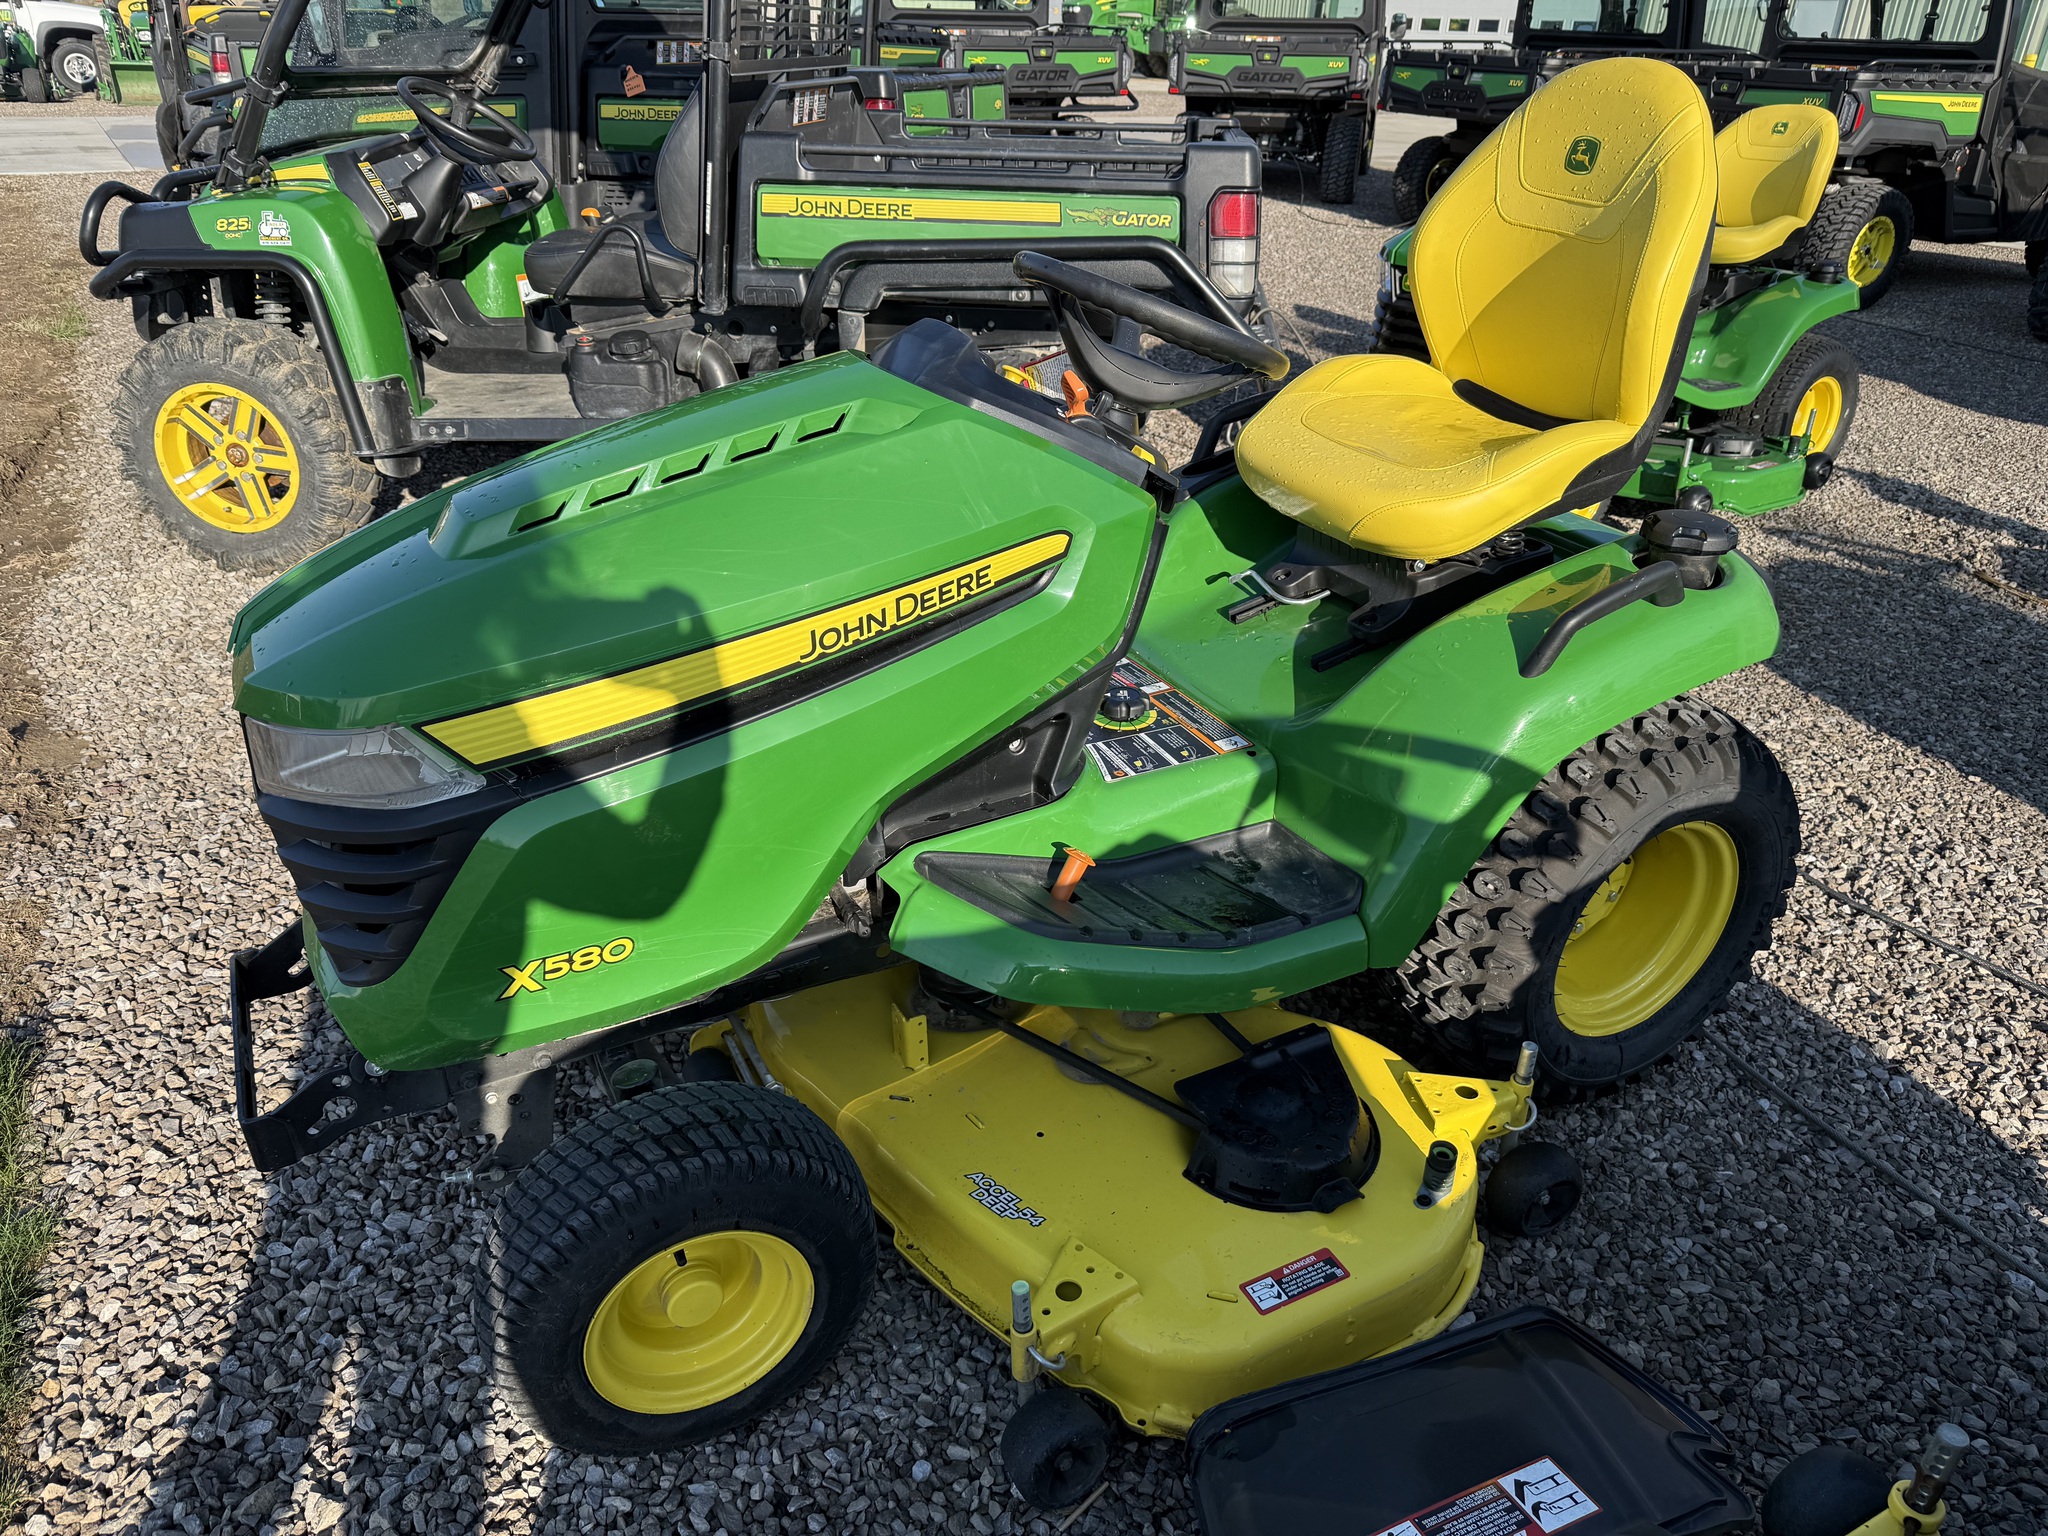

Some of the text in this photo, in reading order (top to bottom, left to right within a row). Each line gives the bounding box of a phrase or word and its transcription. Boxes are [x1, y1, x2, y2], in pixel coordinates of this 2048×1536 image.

[1097, 56, 1112, 64] XUV
[1328, 61, 1344, 69] XUV
[1015, 69, 1069, 82] GATOR
[1237, 71, 1295, 84] GATOR
[1508, 79, 1523, 87] XUV
[1802, 97, 1824, 106] XUV
[1948, 100, 1978, 108] JOHN DEERE
[614, 106, 680, 119] JOHN DEER
[789, 197, 912, 218] JOHN DEERE
[216, 217, 252, 232] 825i
[1112, 211, 1172, 228] GATOR
[800, 564, 991, 660] JOHN DEERE
[495, 936, 635, 1002] X580
[963, 1172, 1022, 1211] ACCEL
[968, 1188, 1047, 1227] DEEP 54
[1288, 1256, 1317, 1271] DANGER
[1282, 1262, 1326, 1283] ROTATING BLADE
[1473, 1485, 1494, 1496] CATCHER
[1473, 1488, 1497, 1501] DISCHARGE
[1455, 1496, 1470, 1504] PLACE
[1463, 1499, 1484, 1510] OPERATE
[1496, 1502, 1512, 1511] BEFORE
[1437, 1508, 1453, 1517] ENTIRE
[1445, 1508, 1464, 1518] MOWER
[1463, 1509, 1482, 1520] THROWN
[1477, 1510, 1507, 1526] THROWN
[1421, 1516, 1438, 1525] GRASS
[1425, 1516, 1446, 1528] WITHOUT
[1443, 1521, 1458, 1529] BLADE
[1465, 1516, 1481, 1525] CLEAR
[1493, 1516, 1511, 1525] MOWER
[1480, 1523, 1495, 1532] WHEN
[1484, 1526, 1499, 1535] HANDS
